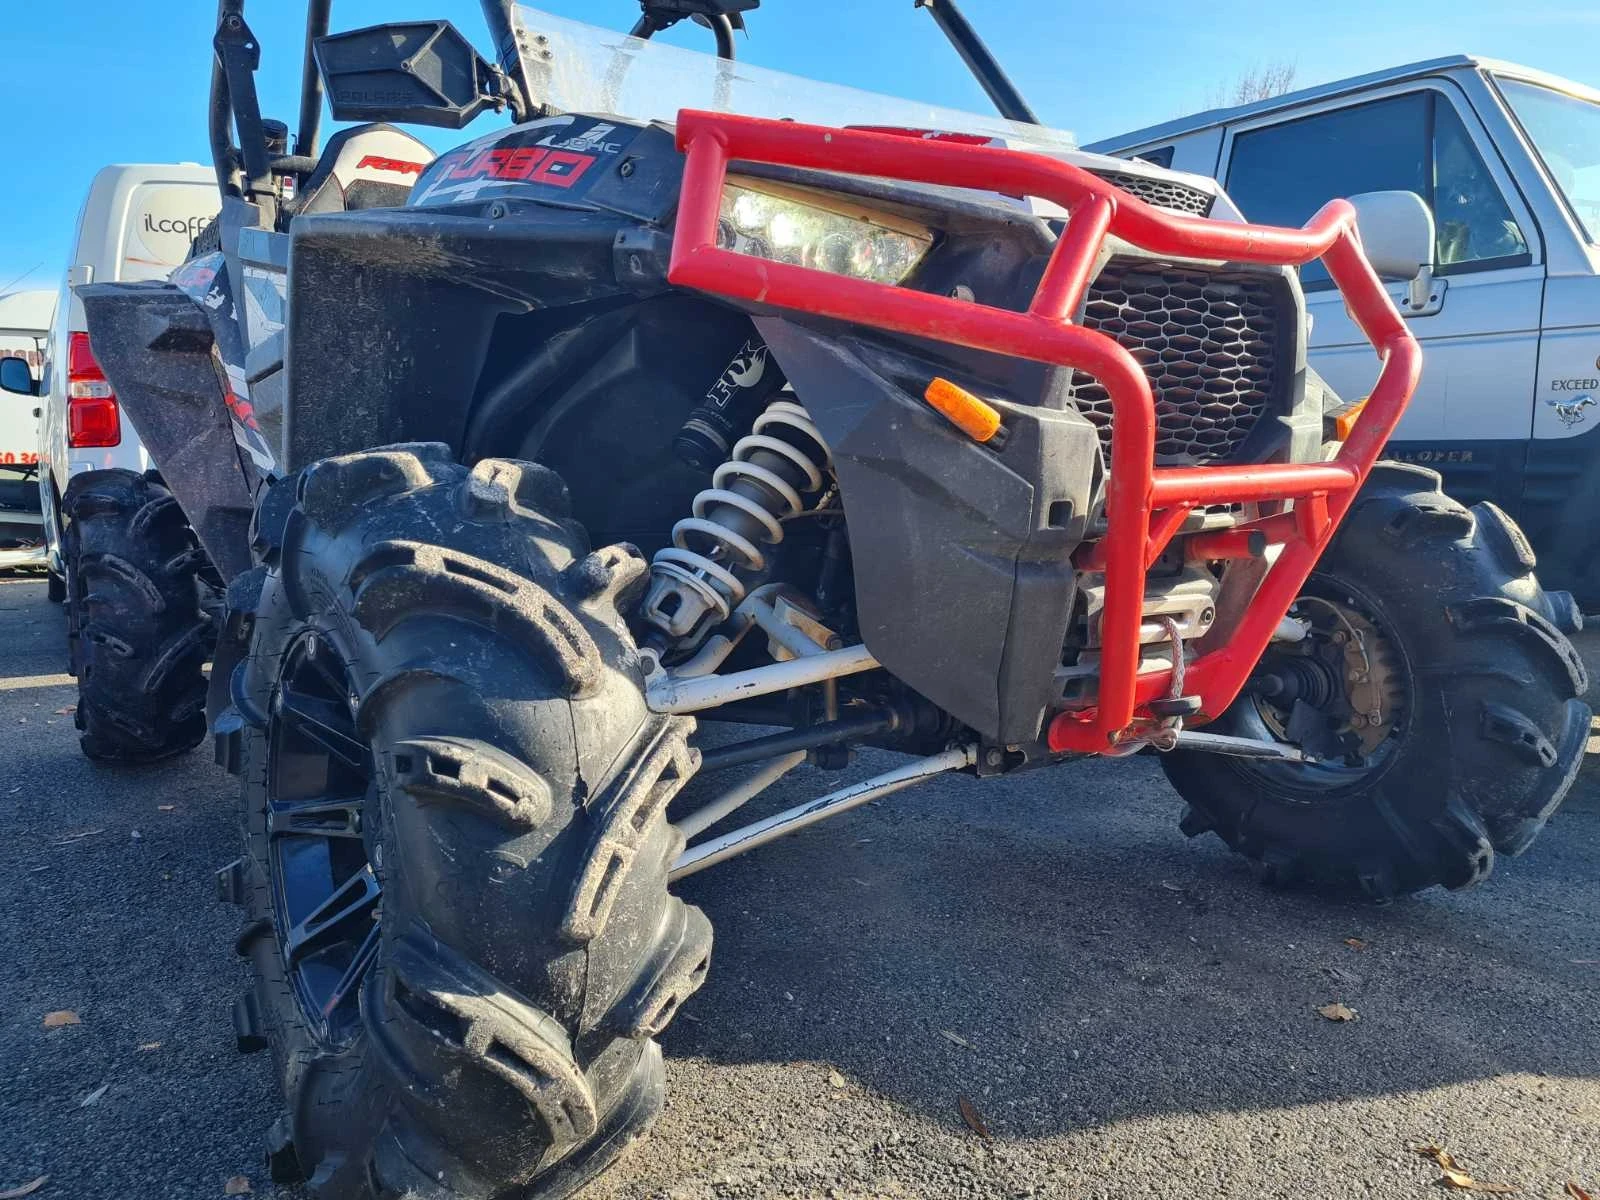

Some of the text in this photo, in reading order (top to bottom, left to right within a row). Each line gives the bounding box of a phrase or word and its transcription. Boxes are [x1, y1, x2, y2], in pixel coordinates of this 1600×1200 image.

[434, 147, 598, 189] TURBO
[144, 213, 216, 244] ilcaff
[1551, 378, 1599, 391] EXCEED
